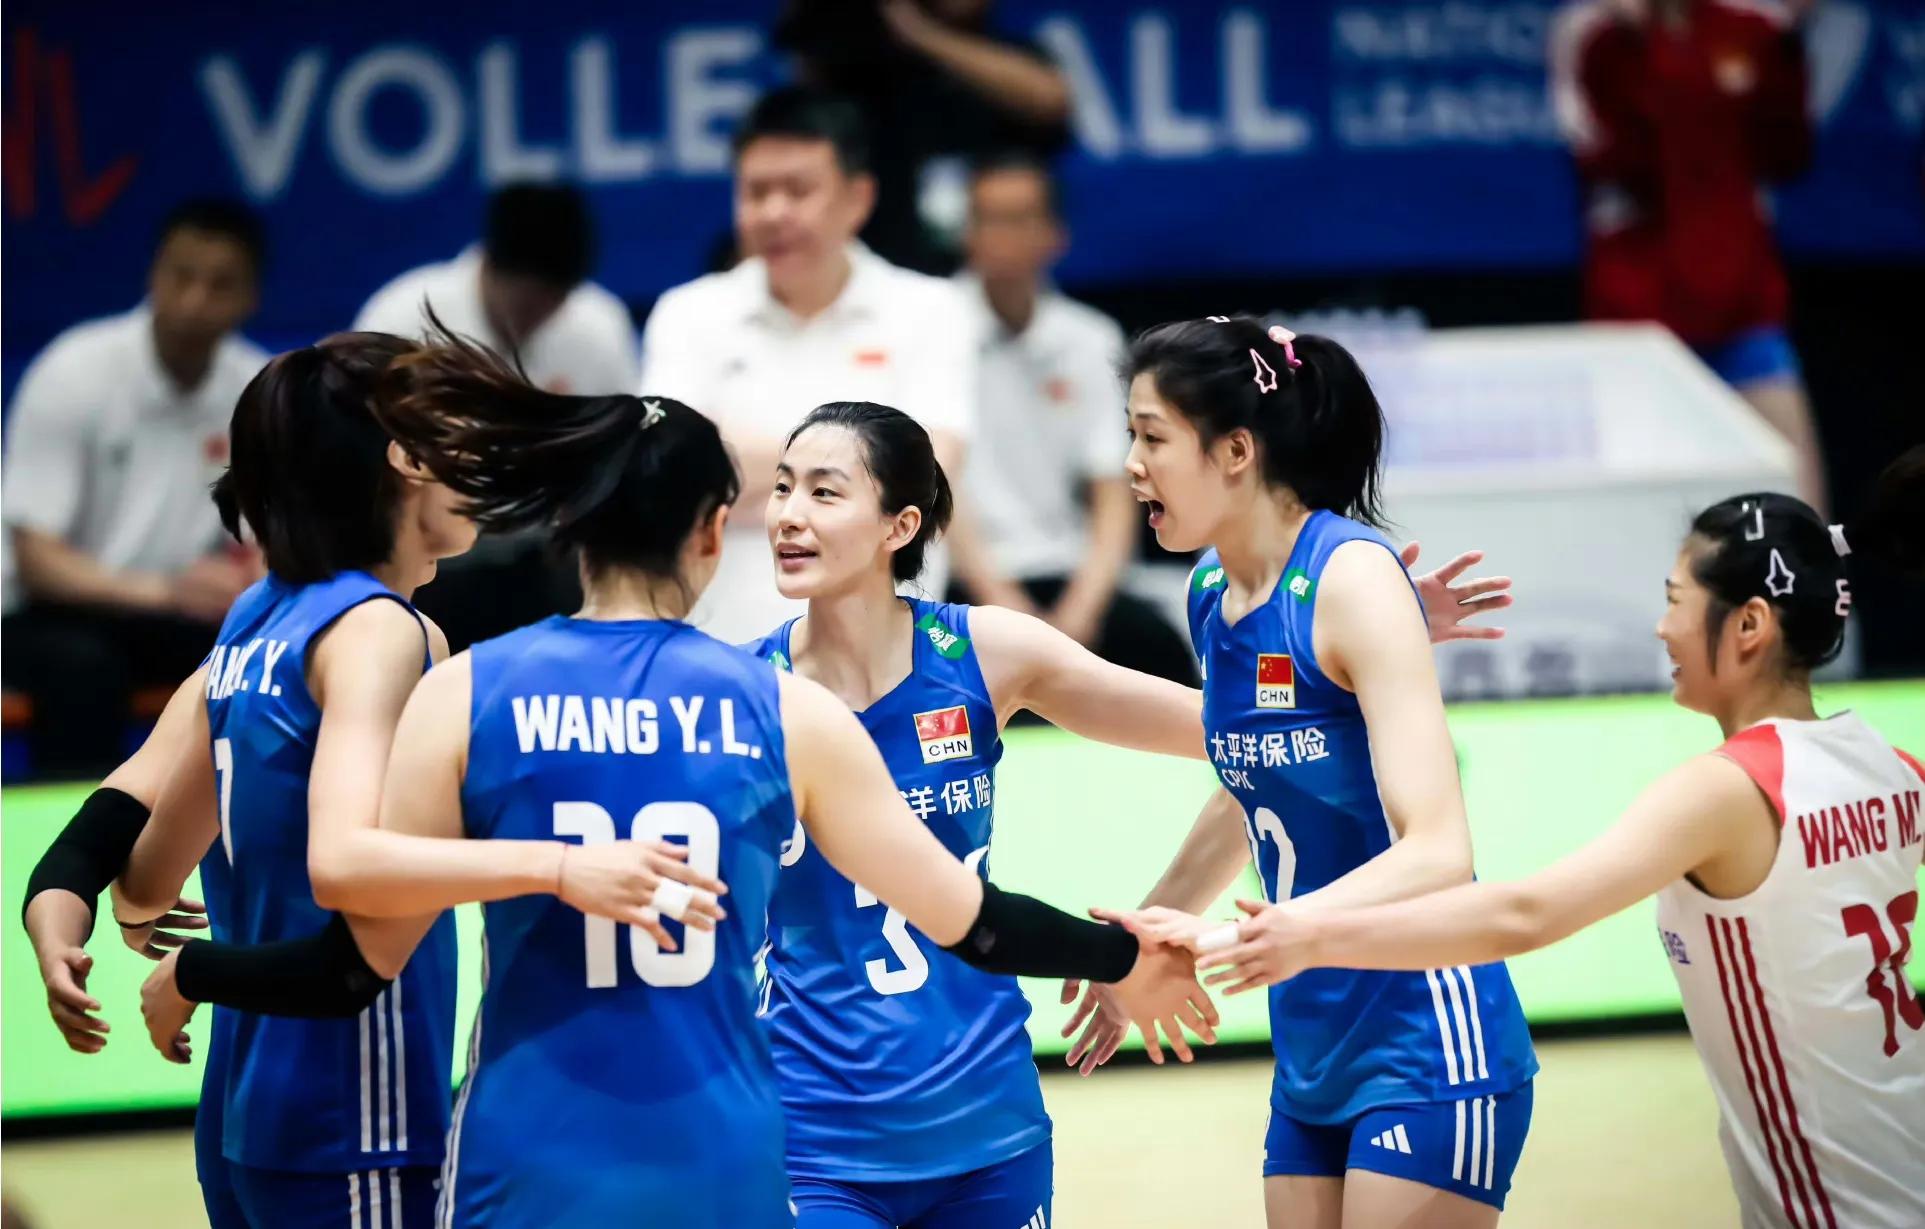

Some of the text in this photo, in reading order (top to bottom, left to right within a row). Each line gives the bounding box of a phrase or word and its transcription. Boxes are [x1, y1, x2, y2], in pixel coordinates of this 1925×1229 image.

[1259, 690, 1289, 703] CHN
[511, 694, 763, 760] WANG Y. L.
[928, 739, 969, 757] CHN
[1210, 726, 1330, 769] 太平洋保险
[1221, 768, 1256, 791] CPIC
[1797, 796, 1889, 869] WANG
